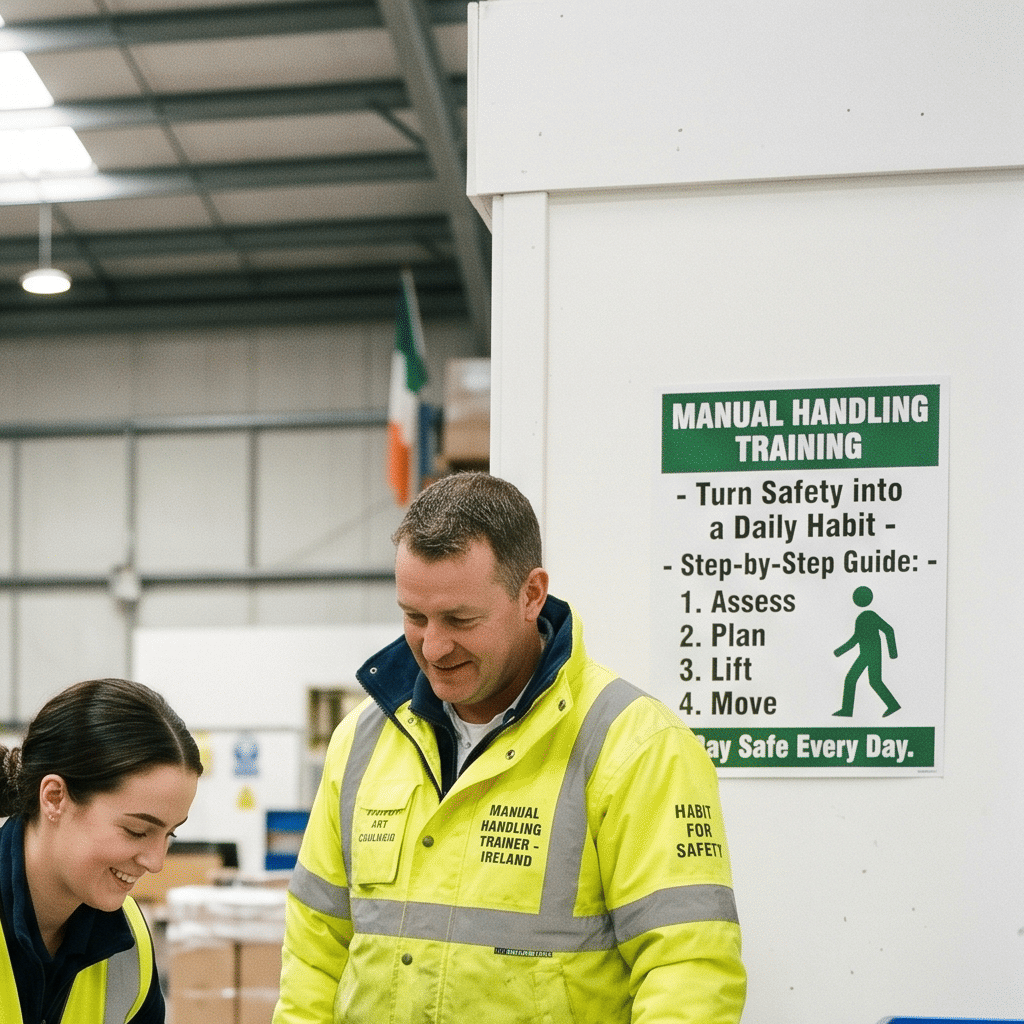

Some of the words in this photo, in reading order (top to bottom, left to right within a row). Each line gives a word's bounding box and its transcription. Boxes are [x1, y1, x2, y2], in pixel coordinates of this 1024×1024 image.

[672, 400, 784, 430] MANUAL
[792, 395, 929, 426] HANDLING
[735, 432, 862, 462] TRAINING
[696, 482, 752, 506] Turn
[761, 479, 843, 509] Safety
[853, 478, 903, 502] into
[709, 520, 724, 540] a
[734, 514, 797, 544] Daily
[807, 512, 876, 537] Habit
[681, 550, 835, 581] Step-by-Step
[843, 550, 919, 574] Guide:
[681, 591, 702, 613] 1.
[711, 590, 796, 613] Assess
[679, 624, 702, 647] 2.
[711, 623, 766, 647] Plan
[679, 658, 701, 681] 3.
[711, 657, 752, 682] Lift
[679, 692, 701, 715] 4.
[711, 691, 777, 715] Move
[738, 734, 789, 758] Safe
[797, 734, 859, 763] Every
[866, 734, 914, 763] Day.
[489, 804, 540, 820] MANUAL
[675, 804, 712, 819] HABIT
[480, 820, 542, 837] HANDLING
[686, 823, 712, 838] FOR
[480, 835, 529, 851] TRAINER
[676, 842, 723, 858] SAFETY
[480, 851, 532, 867] IRELAND
